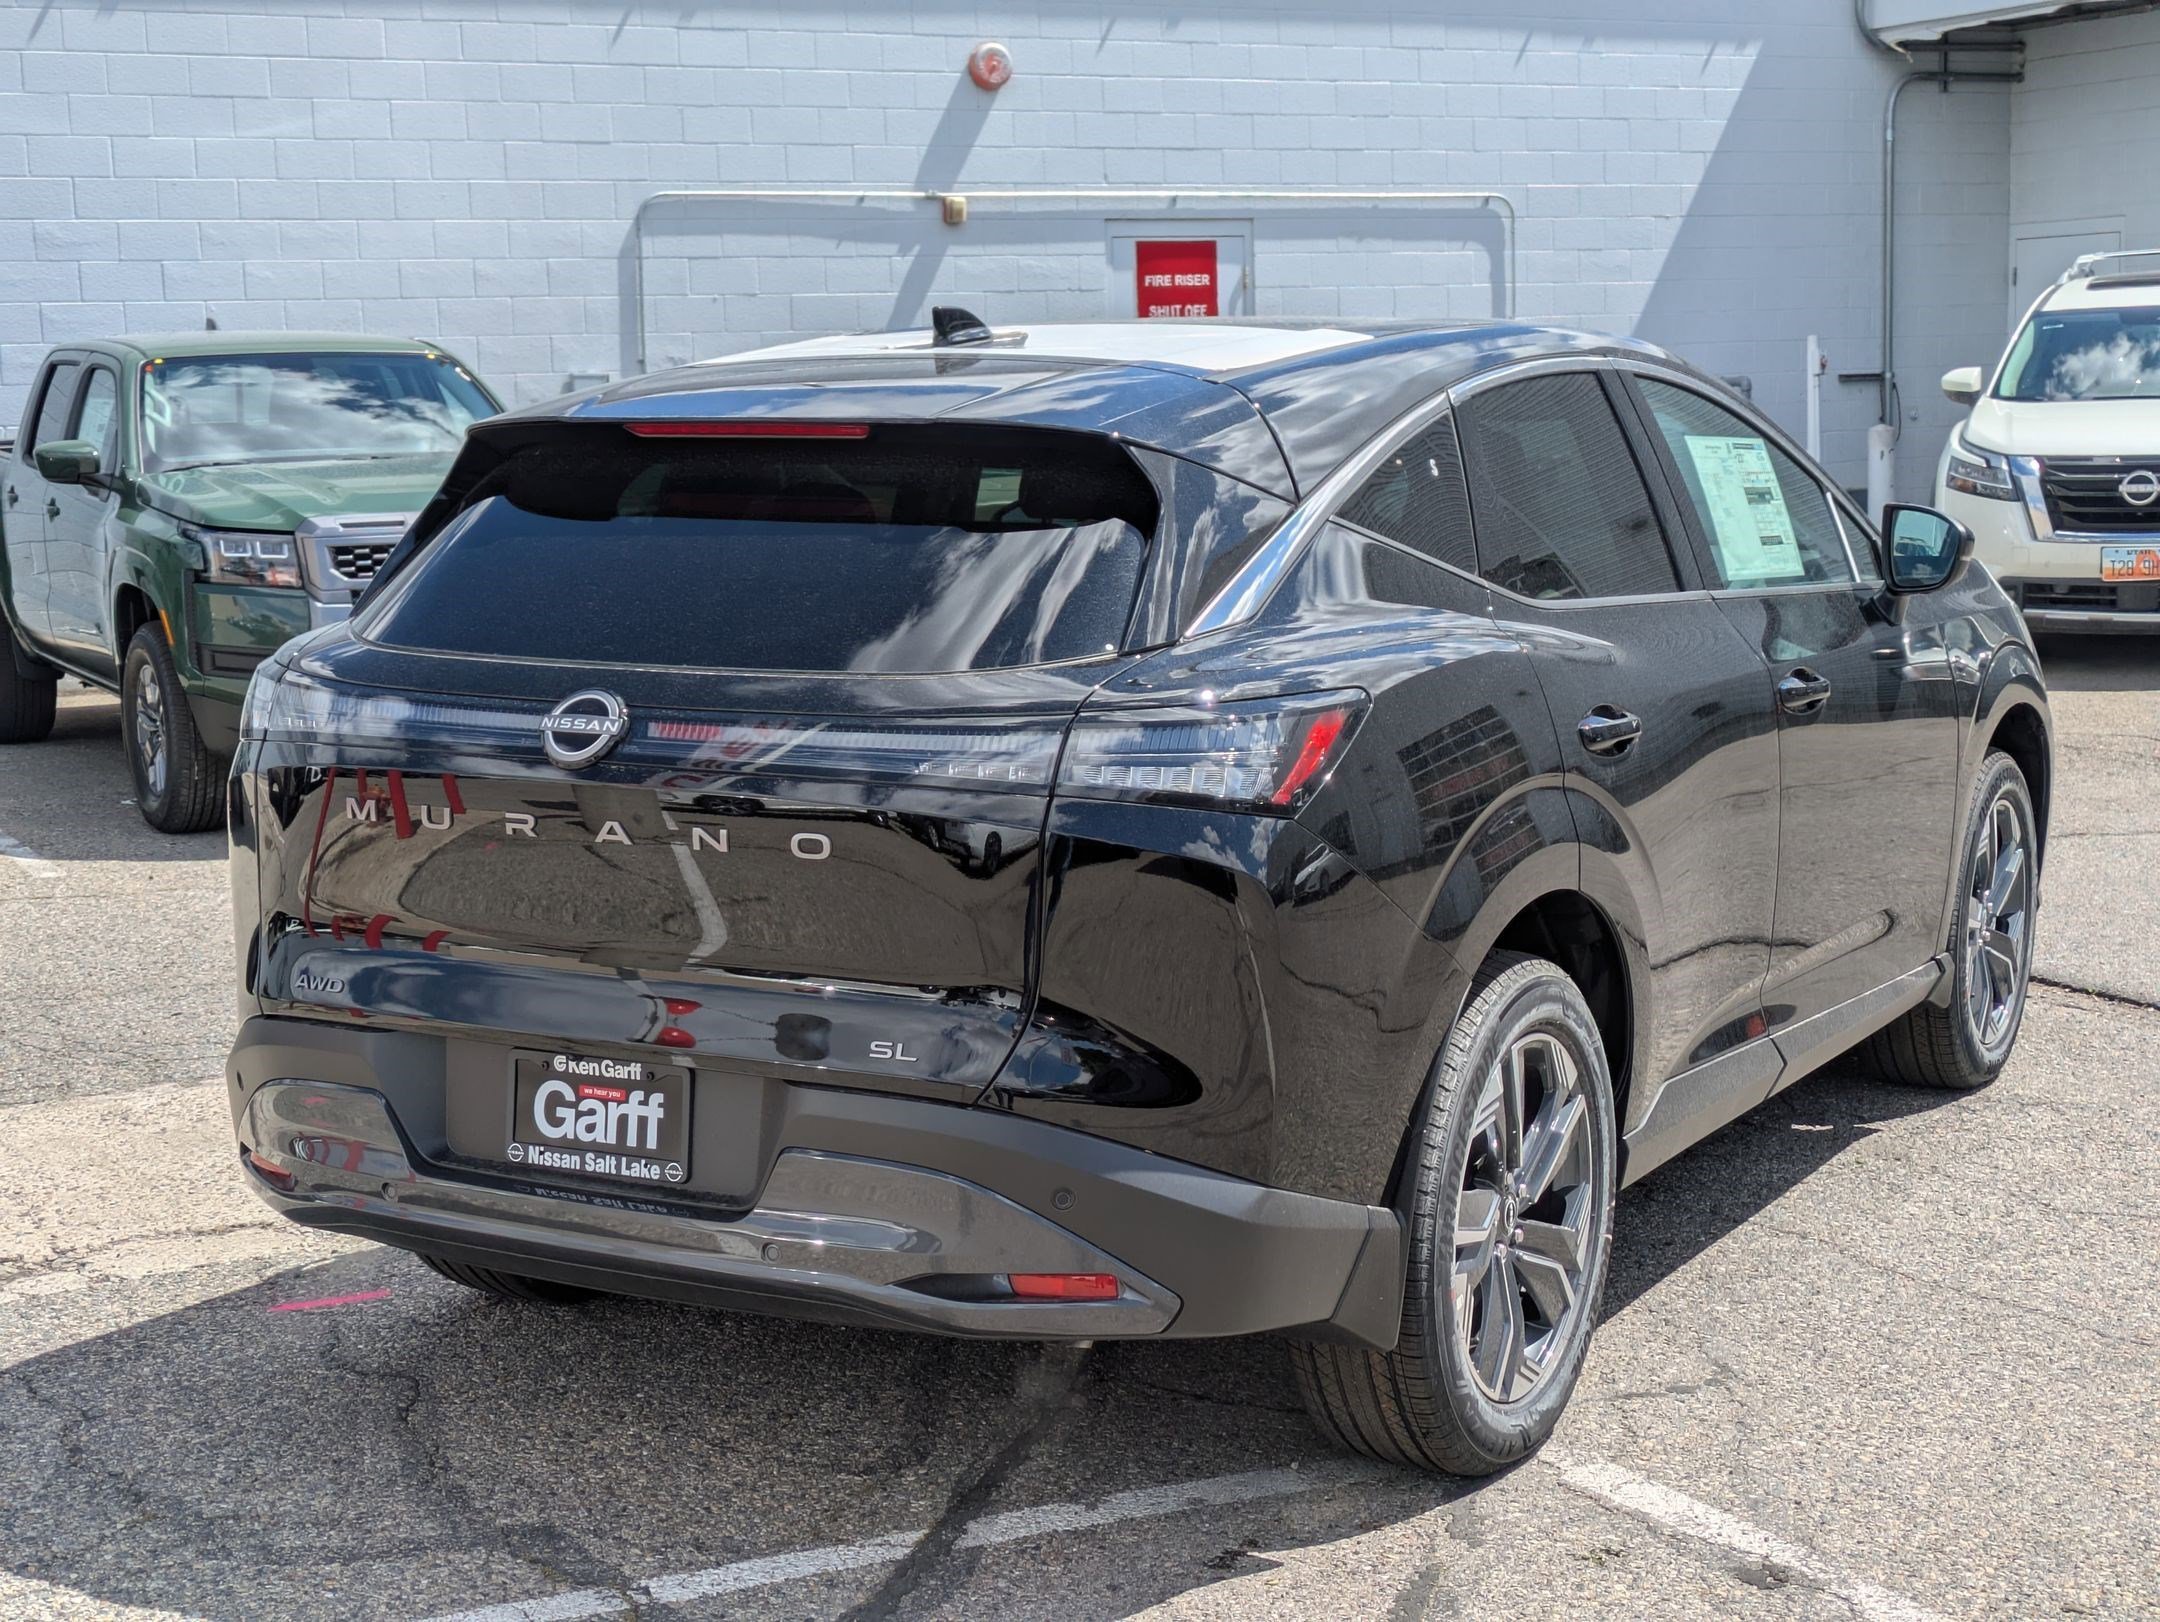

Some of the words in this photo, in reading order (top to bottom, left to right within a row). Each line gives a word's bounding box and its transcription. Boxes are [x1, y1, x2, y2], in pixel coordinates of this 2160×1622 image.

[1144, 275, 1172, 287] FIRE
[1175, 274, 1210, 287] RISER
[1148, 304, 1182, 318] SHUT
[1184, 304, 1208, 317] OFF
[541, 714, 621, 734] NISSAN
[345, 795, 834, 861] MURANO
[294, 974, 345, 994] AWD
[869, 1040, 919, 1062] SL
[568, 1058, 600, 1078] Ken
[601, 1059, 642, 1081] Garff
[584, 1087, 592, 1095] we
[593, 1087, 607, 1096] hear
[608, 1090, 621, 1098] you
[533, 1079, 665, 1150] Garff
[528, 1145, 581, 1170] Nissan
[585, 1152, 617, 1174] Salt
[621, 1157, 661, 1180] Lake
